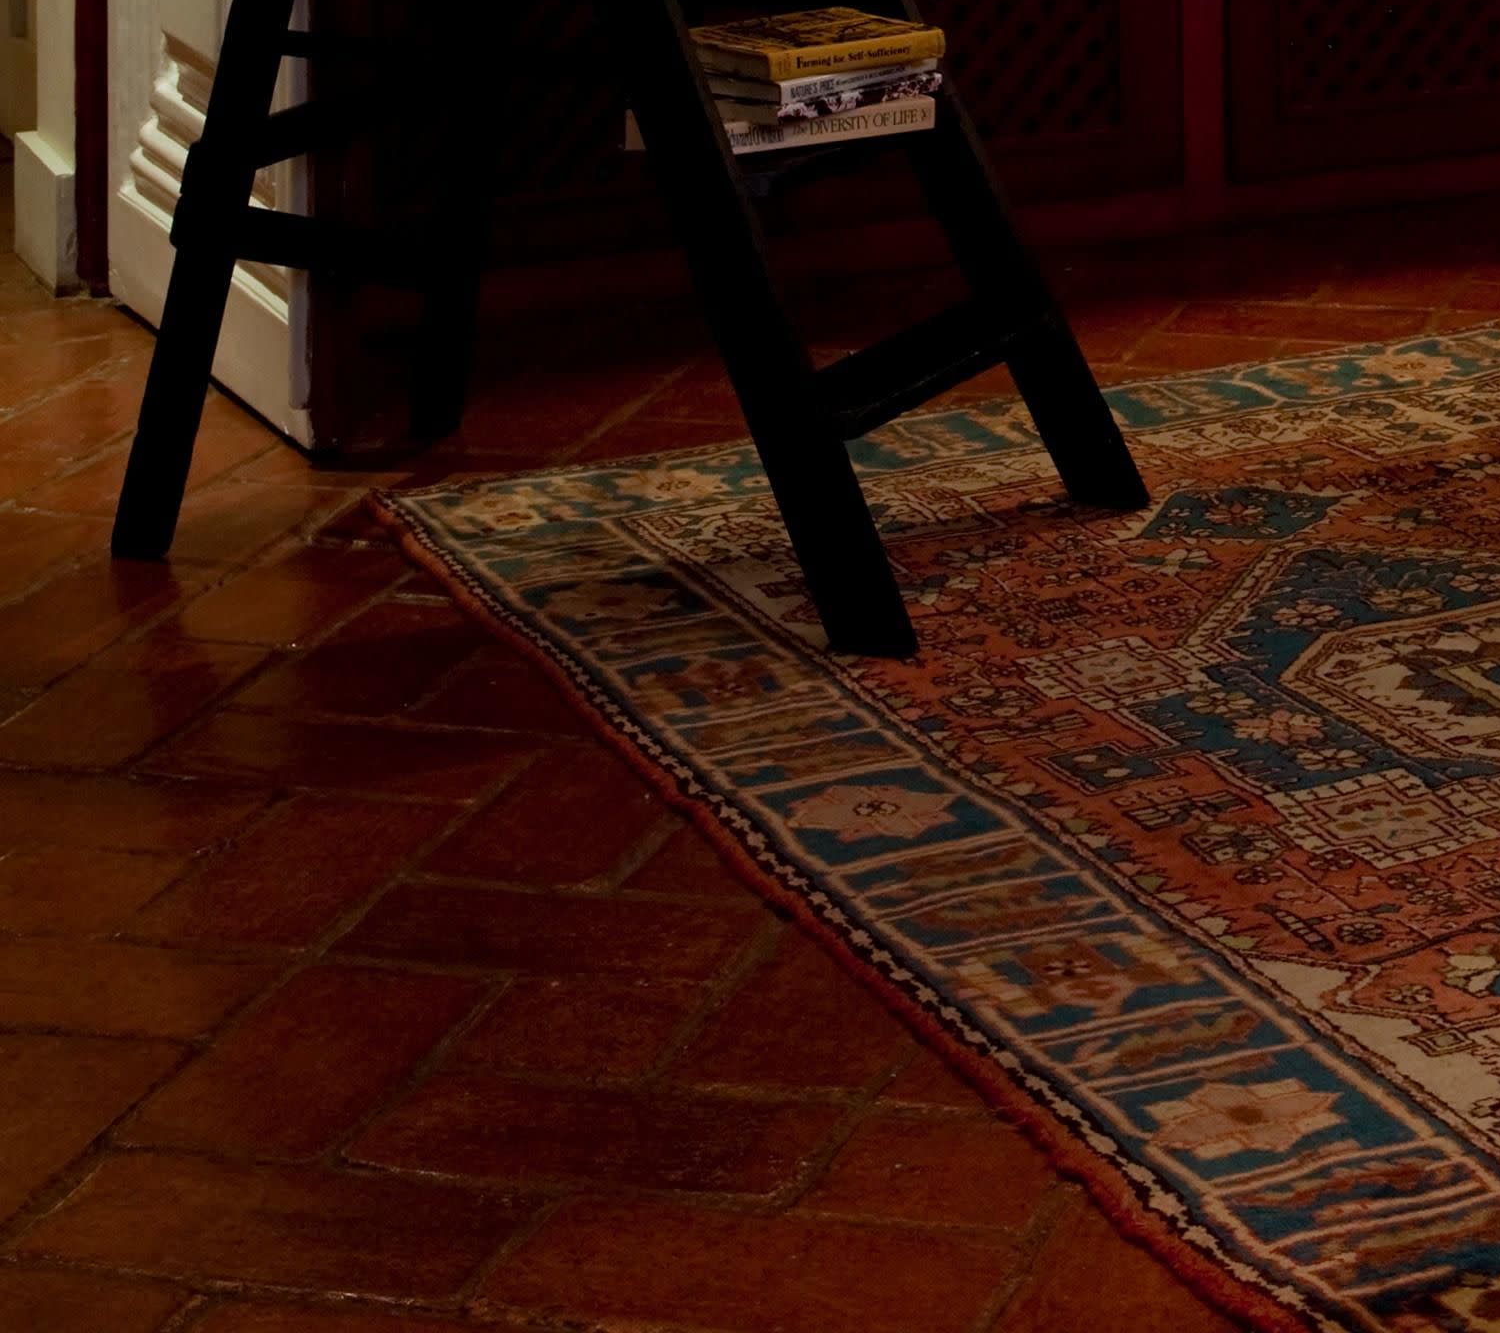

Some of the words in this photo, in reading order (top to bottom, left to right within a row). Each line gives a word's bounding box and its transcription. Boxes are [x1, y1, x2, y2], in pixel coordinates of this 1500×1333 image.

[796, 54, 831, 70] Farming
[833, 54, 845, 65] for
[848, 46, 912, 63] Self-Sufficiency
[809, 114, 871, 137] DIVERSITY
[873, 112, 889, 128] OF
[892, 108, 919, 127] LIFE
